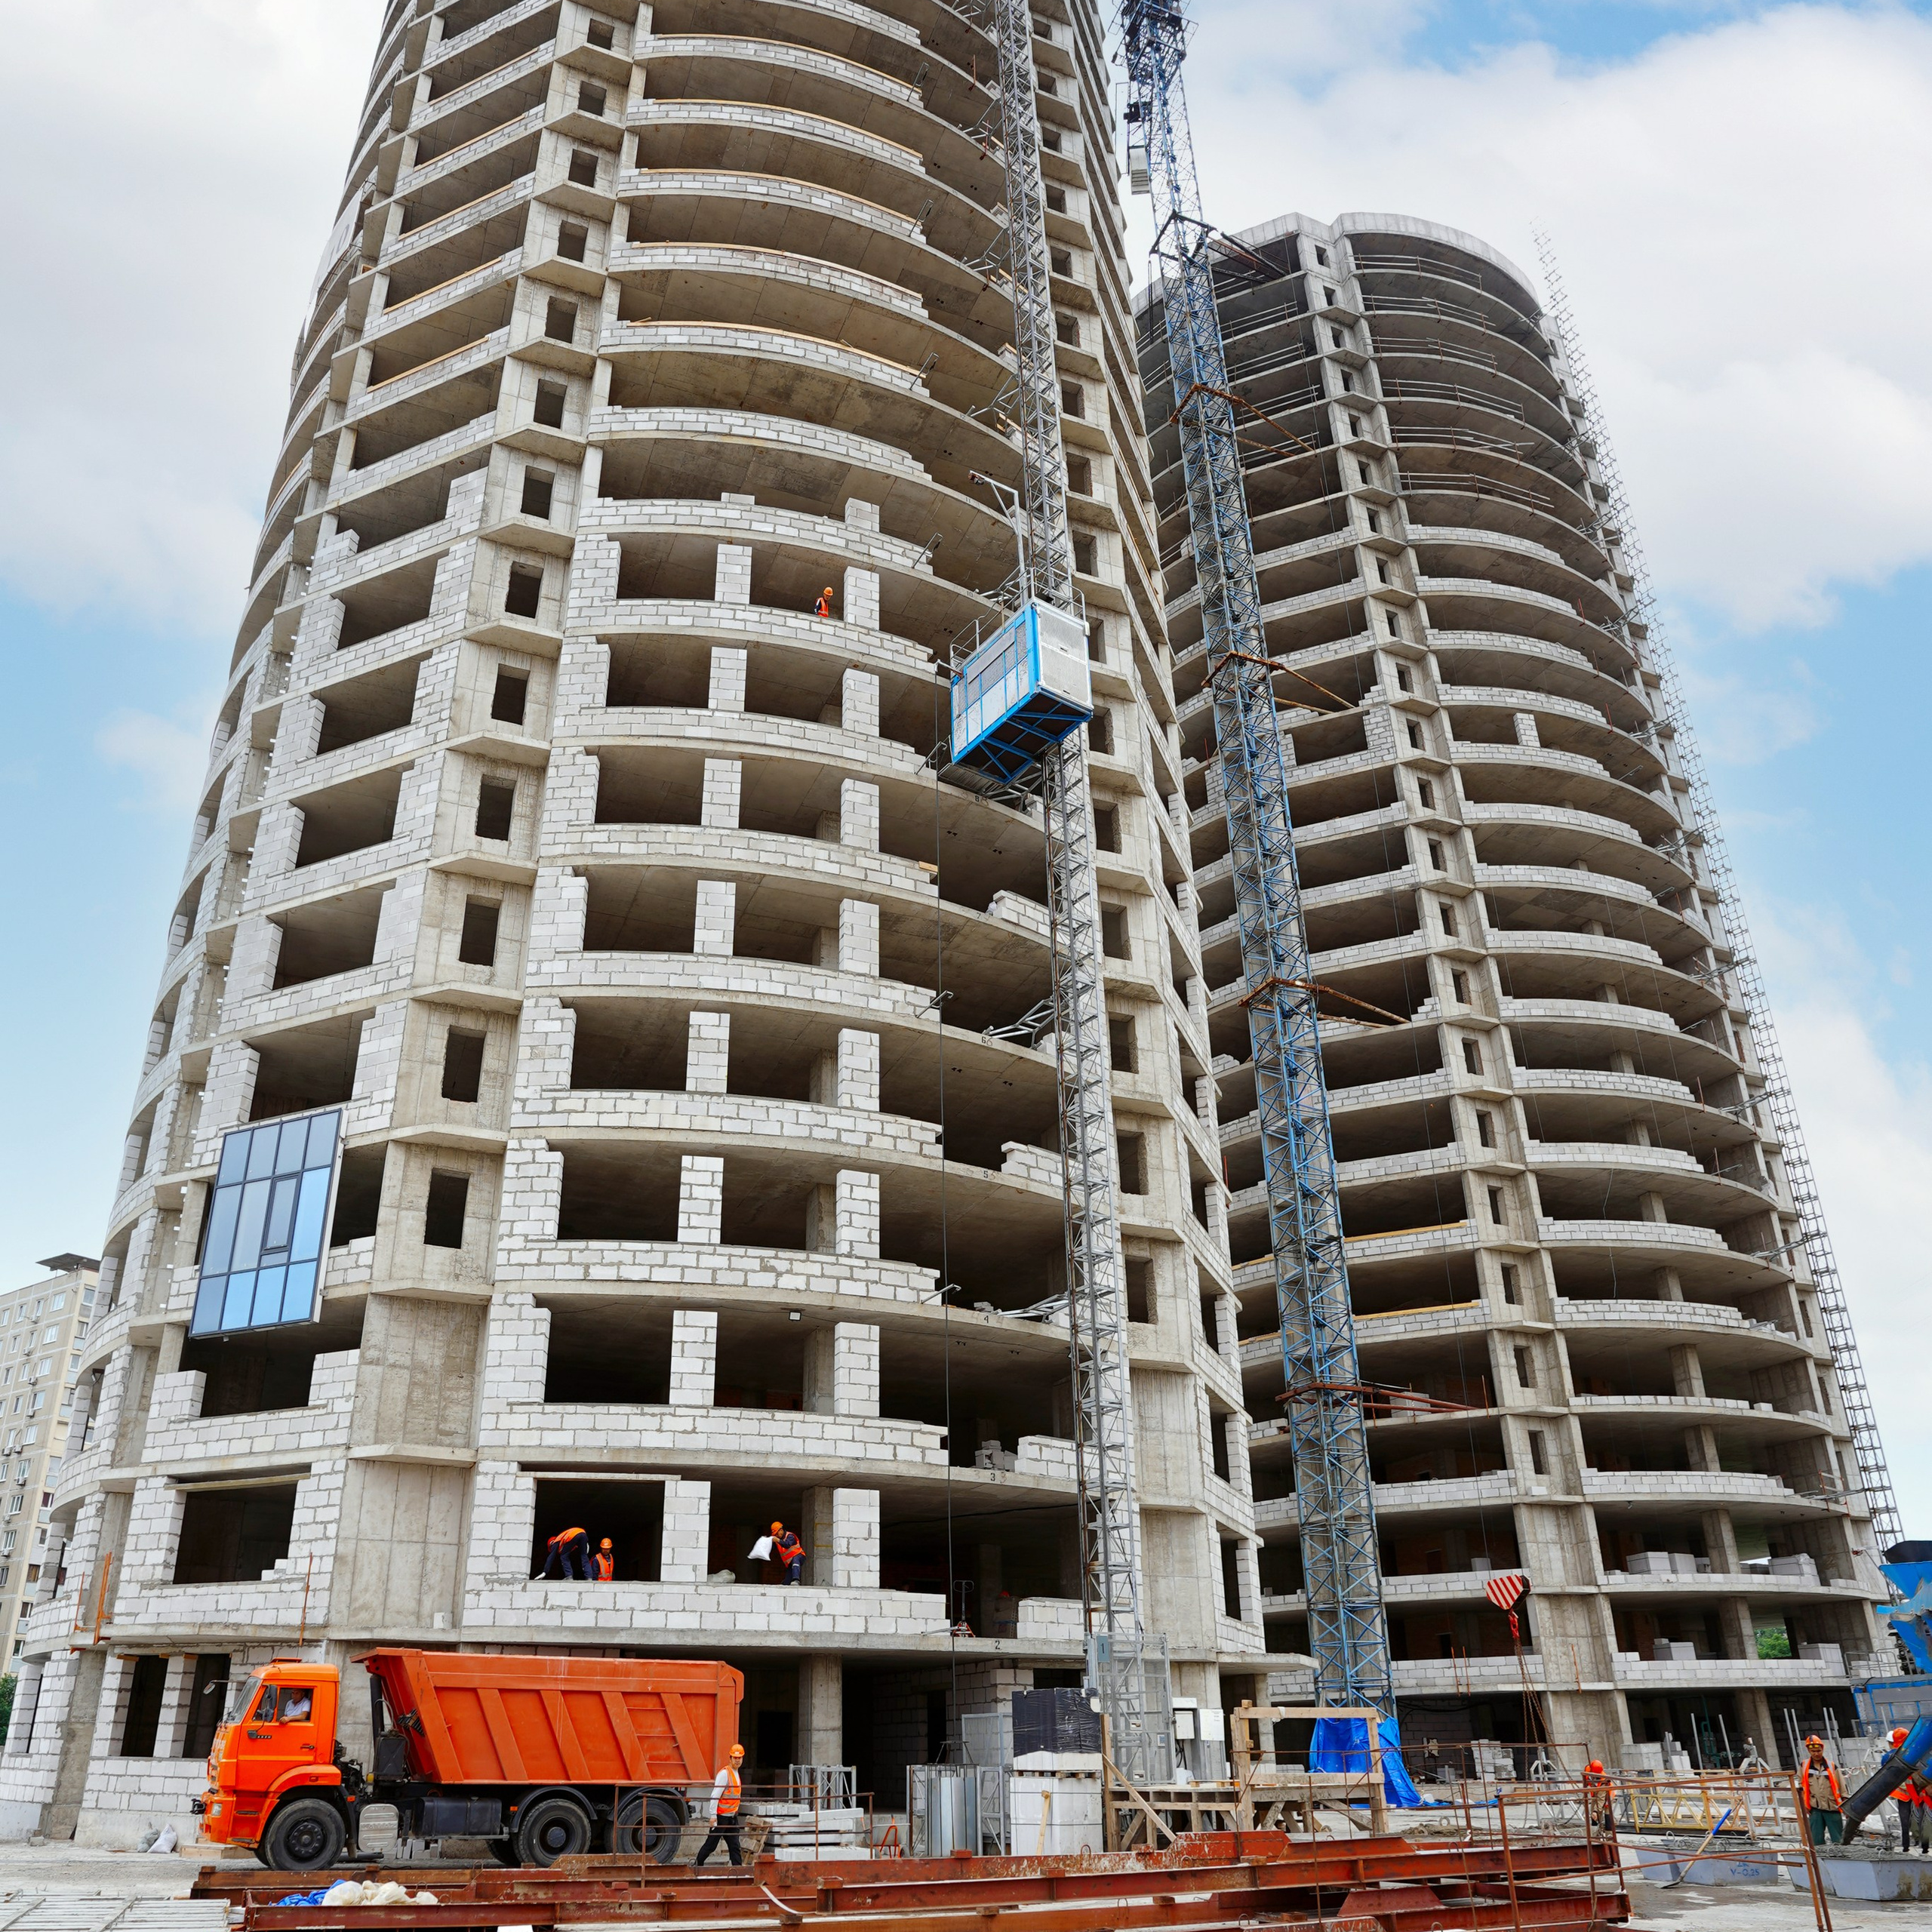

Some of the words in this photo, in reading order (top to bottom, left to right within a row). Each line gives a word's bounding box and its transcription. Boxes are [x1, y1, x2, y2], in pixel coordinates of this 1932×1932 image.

[986, 1037, 993, 1047] 6
[983, 1171, 989, 1179] 5
[990, 1472, 995, 1481] 3
[995, 1640, 1001, 1650] 2
[1100, 1643, 1105, 1654] 1
